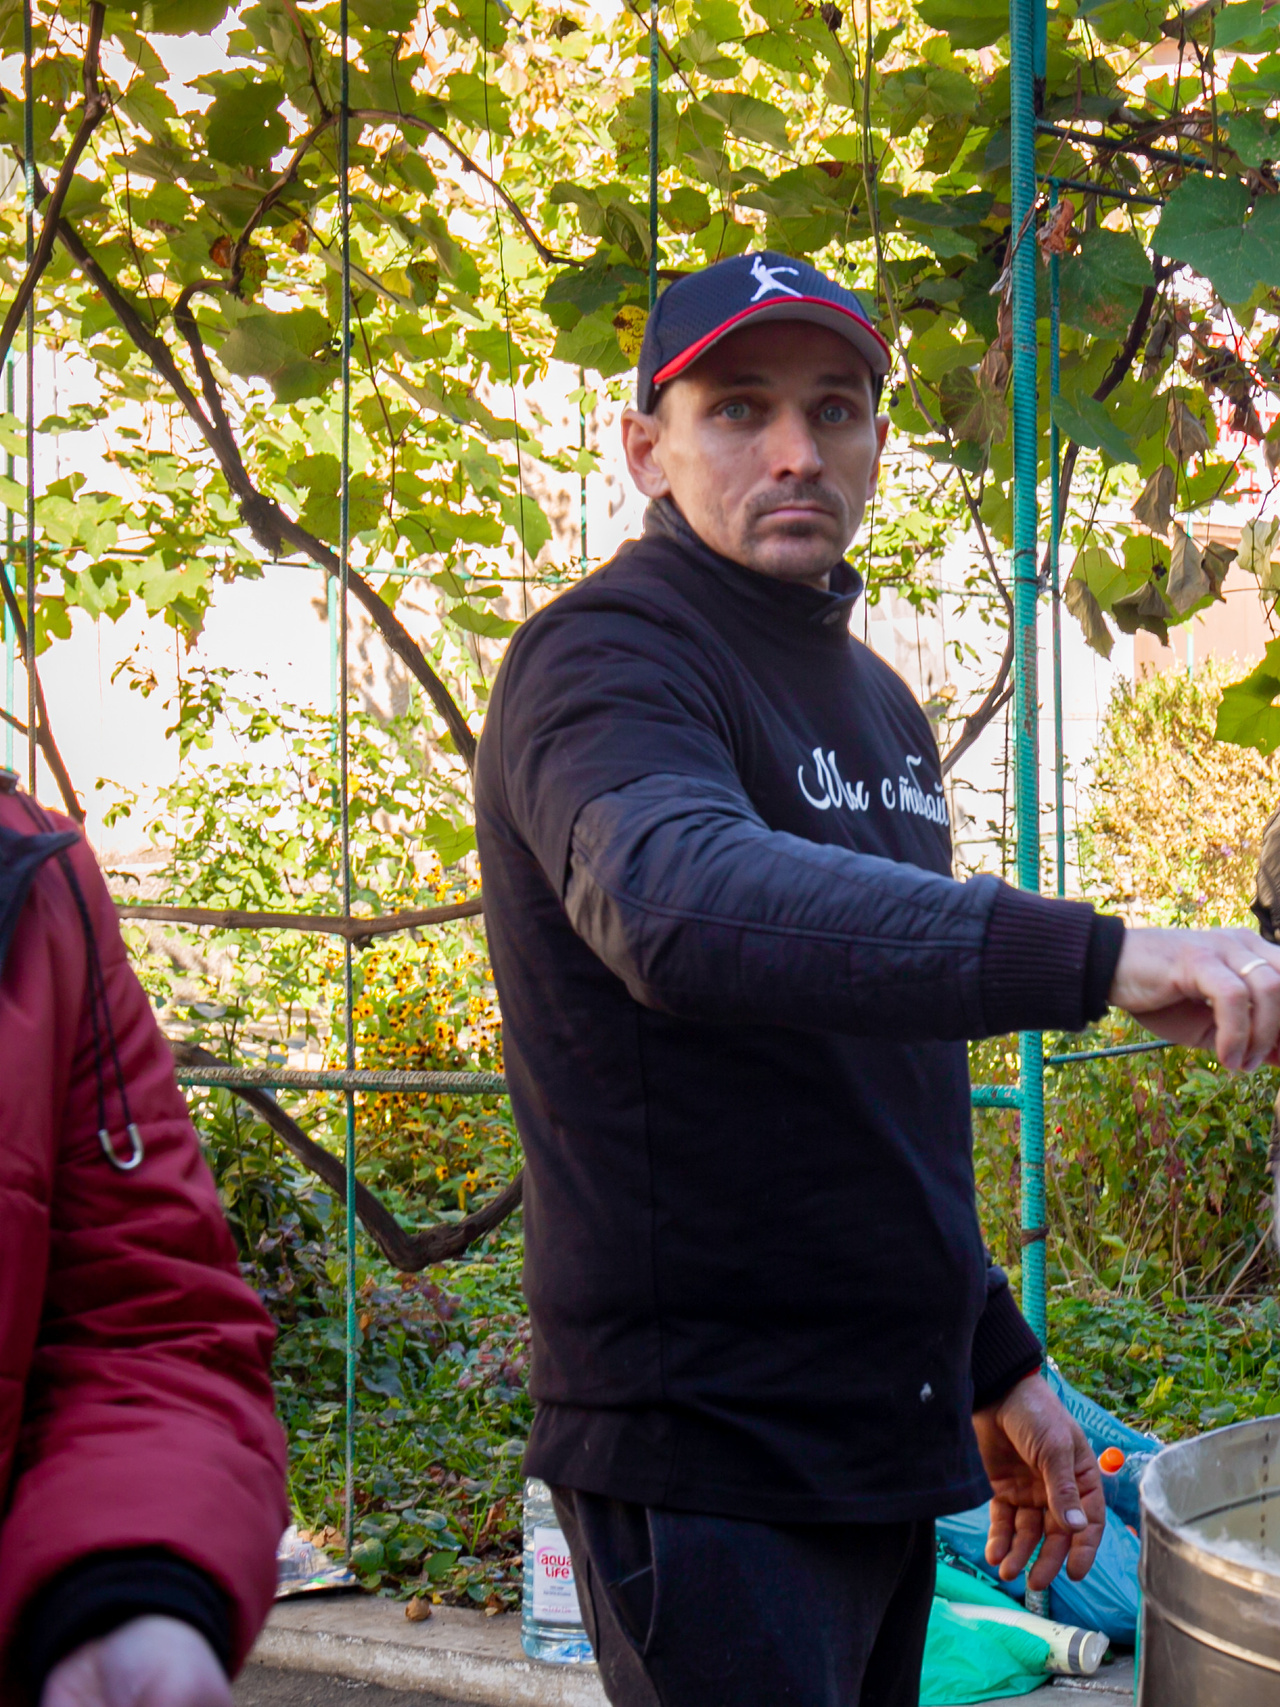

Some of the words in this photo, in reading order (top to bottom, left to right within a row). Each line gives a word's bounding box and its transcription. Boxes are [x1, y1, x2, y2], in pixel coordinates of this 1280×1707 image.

[797, 747, 870, 811] Мы
[881, 777, 896, 810] с
[545, 1566, 570, 1579] life
